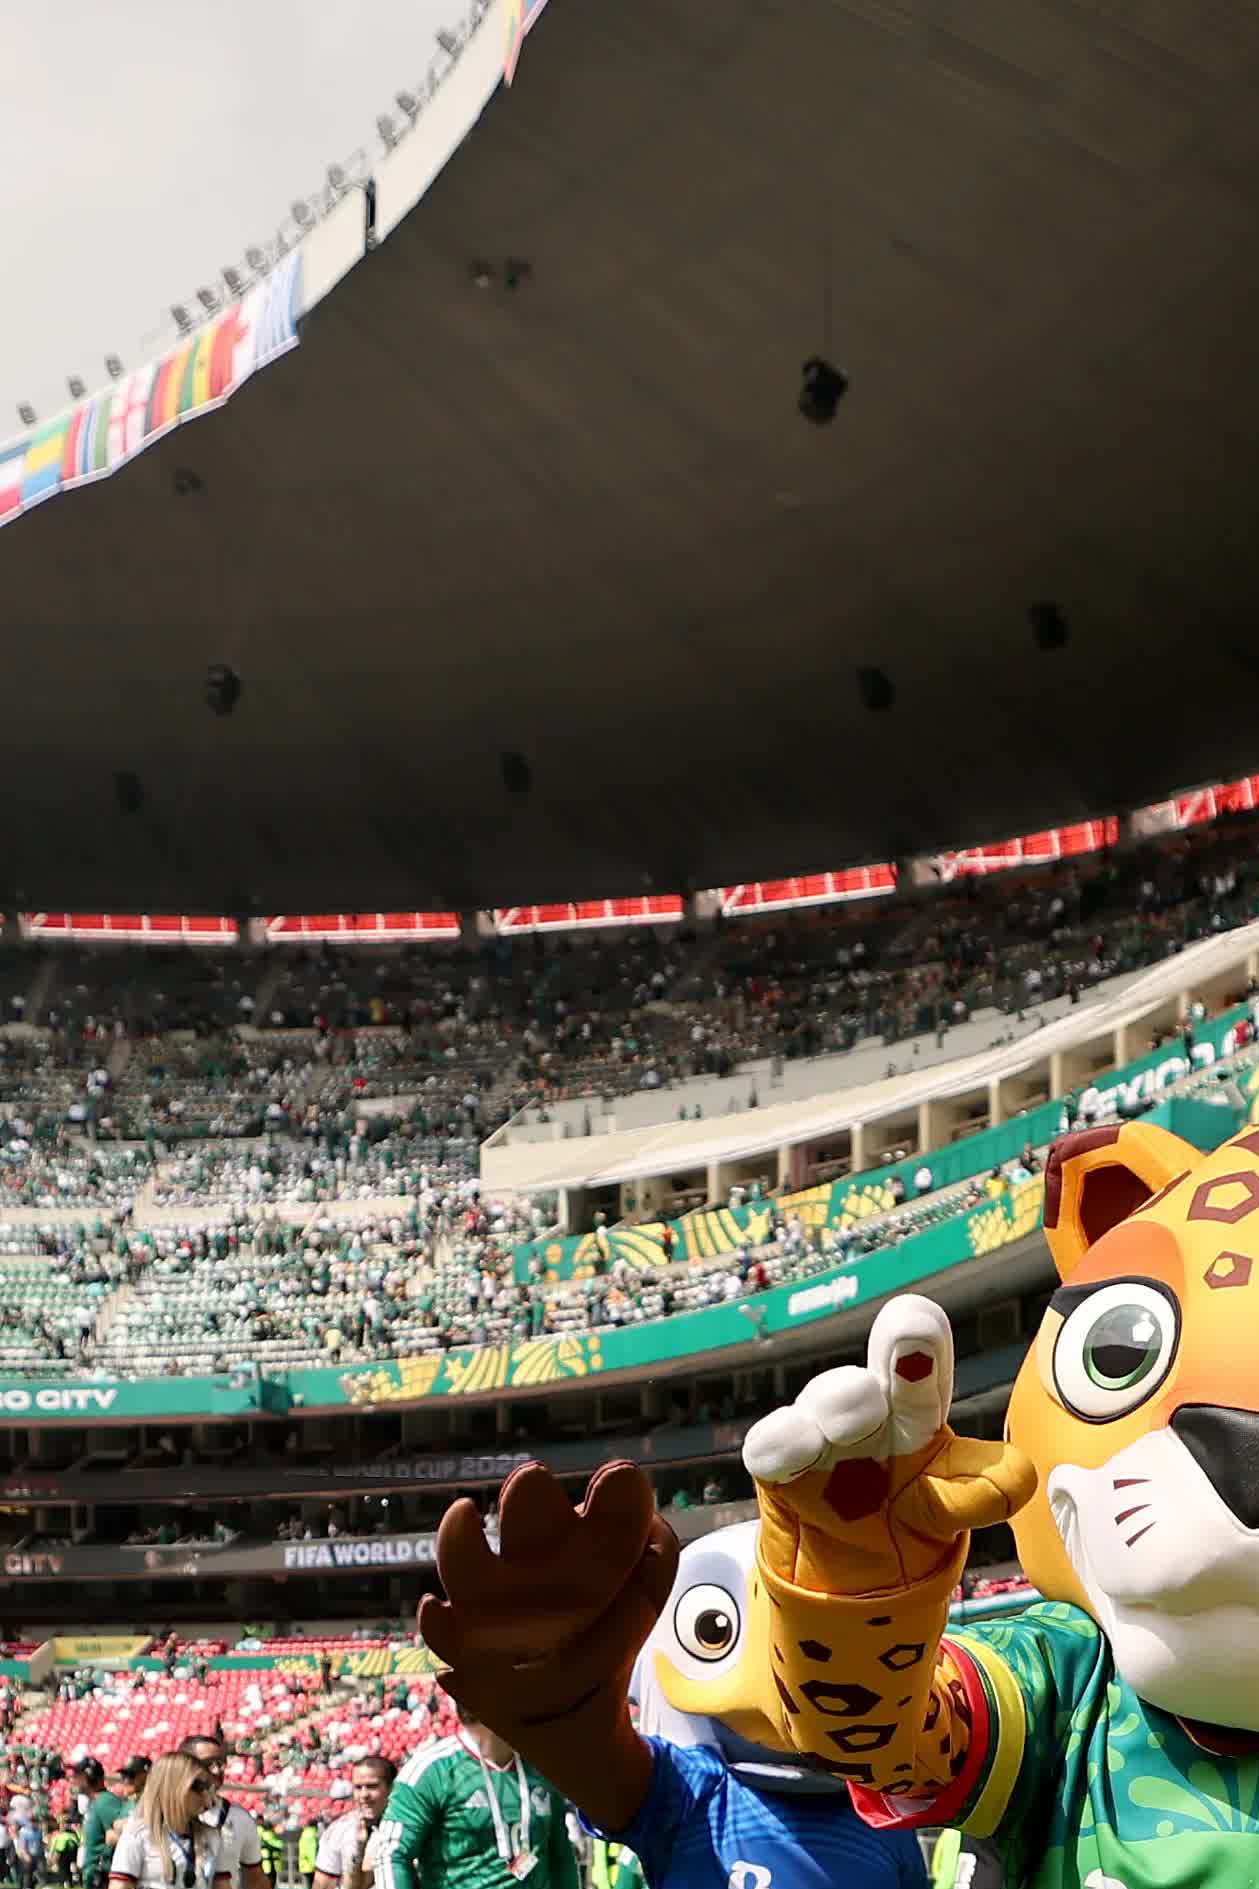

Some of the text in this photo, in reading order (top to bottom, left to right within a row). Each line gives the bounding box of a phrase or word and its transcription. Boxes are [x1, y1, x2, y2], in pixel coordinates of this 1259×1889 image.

[0, 1388, 117, 1412] O CITY
[284, 1545, 334, 1569] FIFA
[333, 1539, 413, 1566] WORLD
